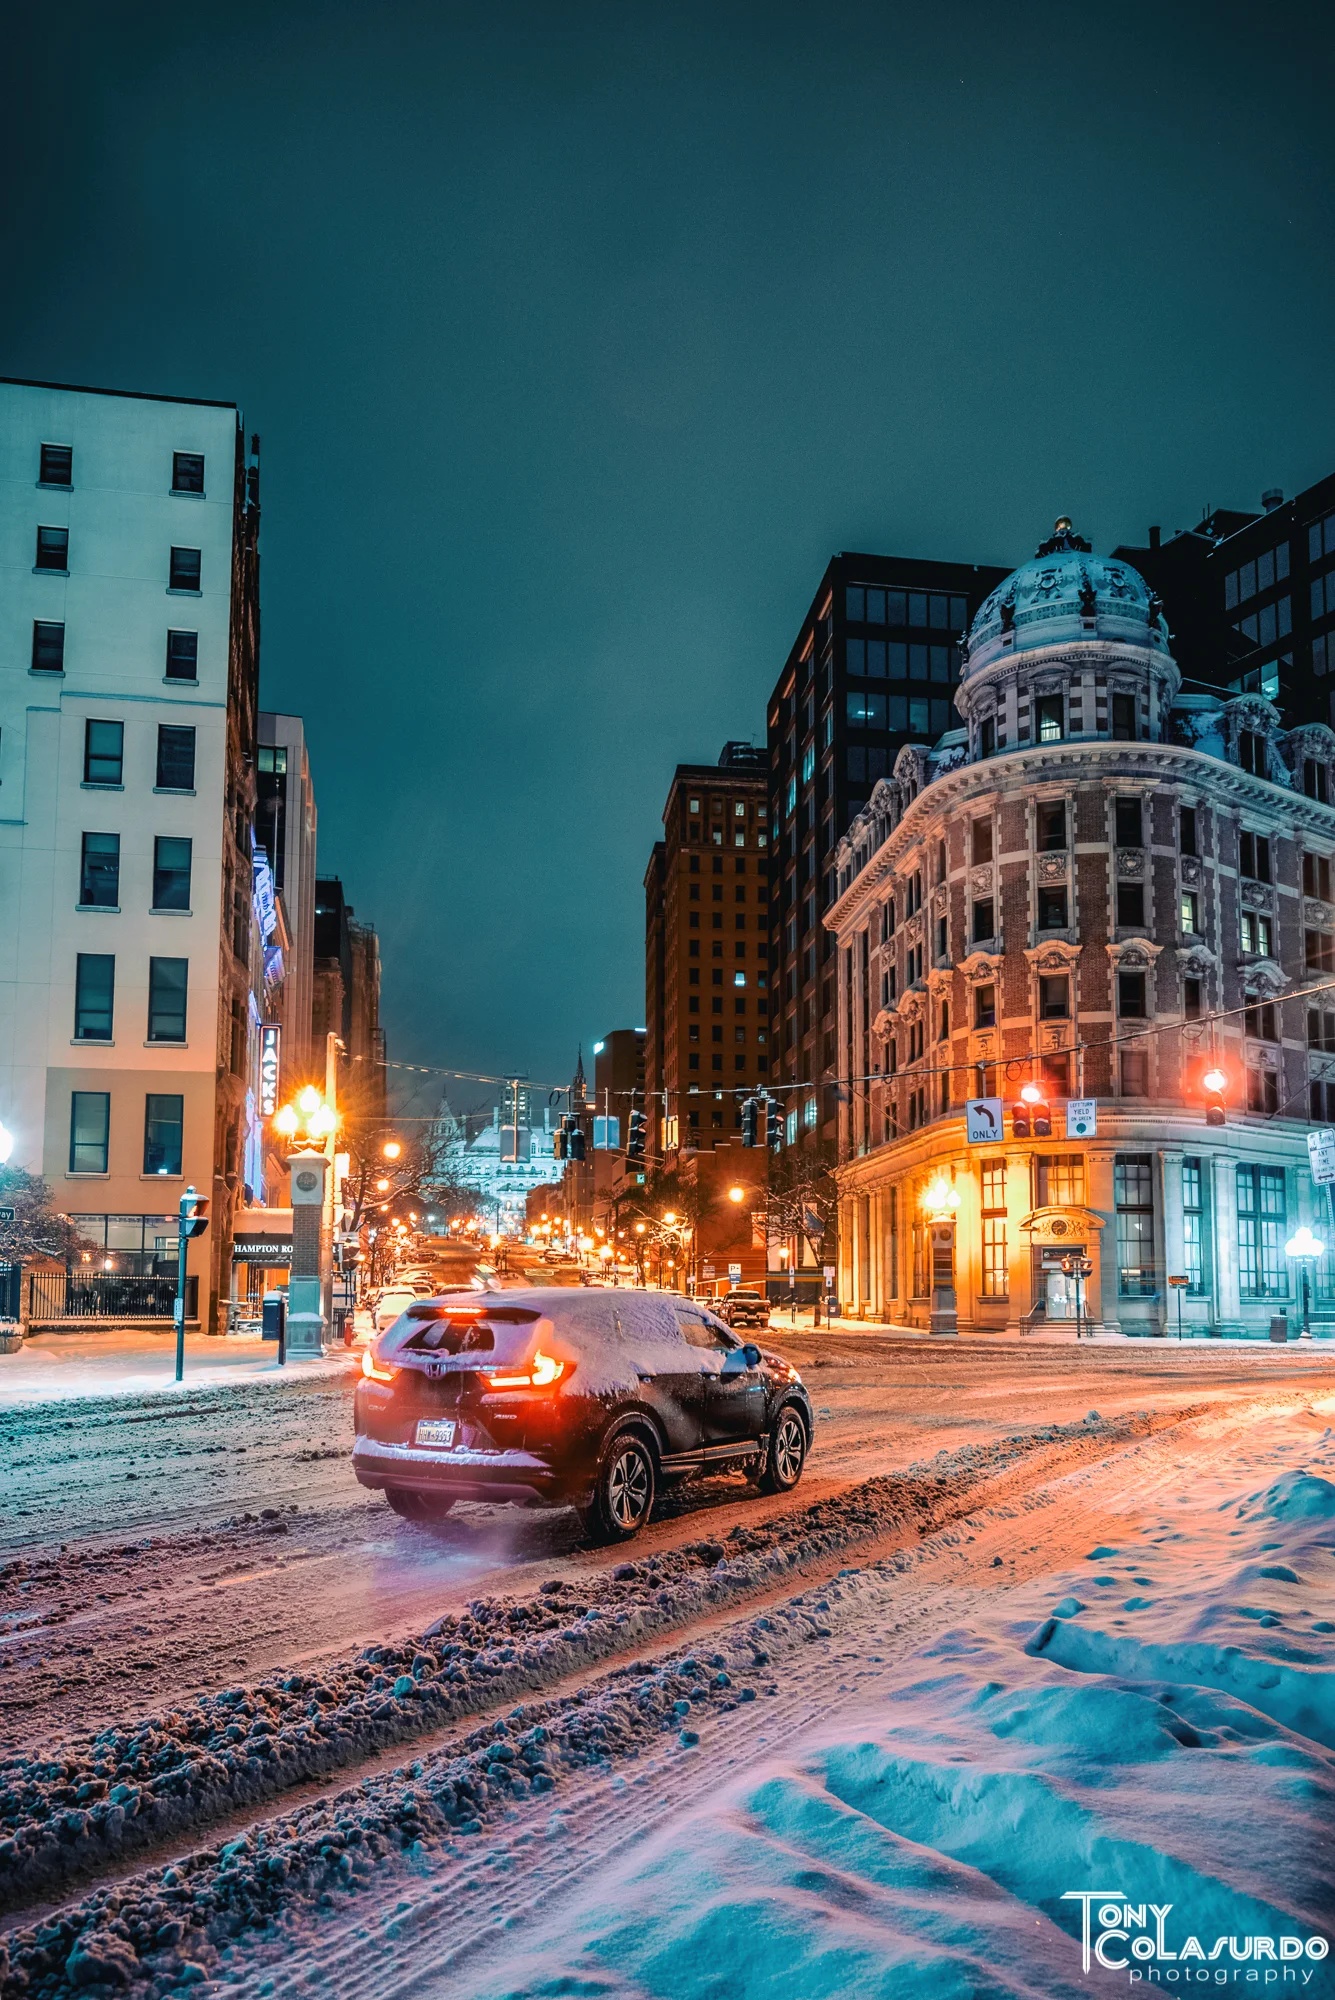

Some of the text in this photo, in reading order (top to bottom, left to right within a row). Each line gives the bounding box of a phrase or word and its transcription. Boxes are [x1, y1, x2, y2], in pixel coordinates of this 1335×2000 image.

[262, 1029, 278, 1116] JACKS
[973, 1129, 998, 1140] ONLY
[234, 1244, 279, 1253] HAMPTON
